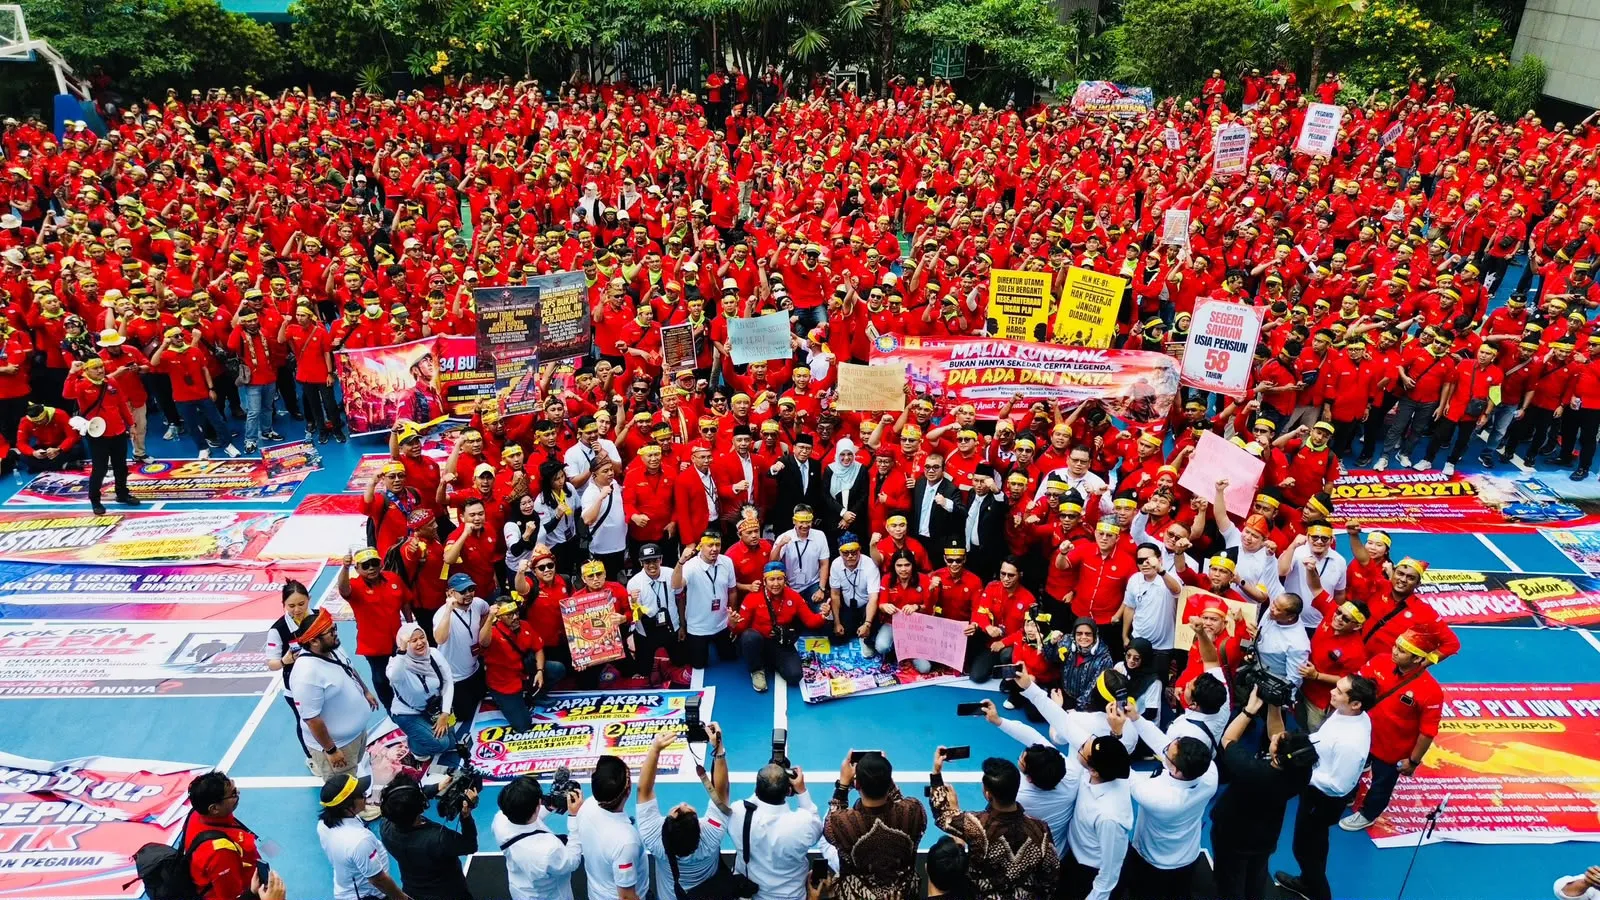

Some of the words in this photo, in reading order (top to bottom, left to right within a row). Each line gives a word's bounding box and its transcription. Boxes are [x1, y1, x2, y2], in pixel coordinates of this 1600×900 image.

[997, 276, 1024, 284] DIREKTUR
[1024, 278, 1044, 286] UTAMA
[998, 284, 1014, 292] BOLEH
[1016, 286, 1042, 295] BERGANTI
[543, 299, 556, 310] APS
[556, 295, 578, 306] BUKAN
[1070, 289, 1083, 298] HAK
[1084, 292, 1112, 307] PEKERJA
[574, 303, 582, 311] INI
[1076, 302, 1102, 314] JANGAN
[542, 310, 582, 324] PERJUANGAN
[1008, 316, 1026, 324] TETAP
[1068, 310, 1104, 326] DIABAIKAN!
[1210, 311, 1244, 327] SEGERA
[1006, 326, 1026, 334] HARGA
[1206, 324, 1242, 340] SAHKAN
[1194, 334, 1212, 348] USIA
[1214, 338, 1248, 353] PENSIUN
[950, 341, 1011, 360] MALIN
[1015, 344, 1109, 362] KUNDANG
[440, 356, 454, 372] 34
[950, 360, 978, 368] BUKAN
[978, 360, 1005, 368] HANYA
[1044, 362, 1072, 370] CERITA
[1204, 348, 1230, 372] 58
[948, 368, 978, 386] DIA
[981, 368, 1015, 384] ADA
[1020, 369, 1056, 384] DAN
[1060, 372, 1114, 386] NYATA
[1206, 371, 1222, 380] TAHUN
[210, 466, 256, 474] PLN
[1382, 474, 1448, 483] SELURUH
[1330, 482, 1474, 498] 2025-2027!
[26, 574, 74, 582] JAGA
[74, 574, 142, 582] LISTRIK
[142, 574, 162, 582] DI
[164, 574, 254, 582] INDONESIA
[0, 582, 46, 590] KALO
[47, 582, 72, 590] GA
[136, 582, 202, 592] DIMAKI
[202, 583, 248, 592] ATAU
[1418, 586, 1439, 594] yang
[1461, 584, 1488, 592] bilang
[1518, 582, 1568, 596] Bukan,
[4, 630, 62, 638] KOK
[68, 628, 127, 636] BISA
[602, 696, 660, 706] AKBAR
[568, 706, 596, 717] SP
[598, 704, 639, 714] PLN
[1452, 700, 1482, 717] SP
[1482, 700, 1530, 717] PLN
[1524, 700, 1572, 717] UIW
[608, 724, 620, 735] 2
[627, 719, 680, 727] TUNTASKAN
[1512, 722, 1556, 730] PAPUA
[487, 728, 498, 740] 1
[503, 728, 566, 742] DOMINASI
[508, 739, 550, 747] TEGAKKAN
[555, 740, 575, 748] AYAT
[498, 762, 532, 776] KAMI
[534, 759, 566, 772] YAKIN
[92, 780, 164, 802] ULP
[22, 856, 104, 868] PEGAWAI
